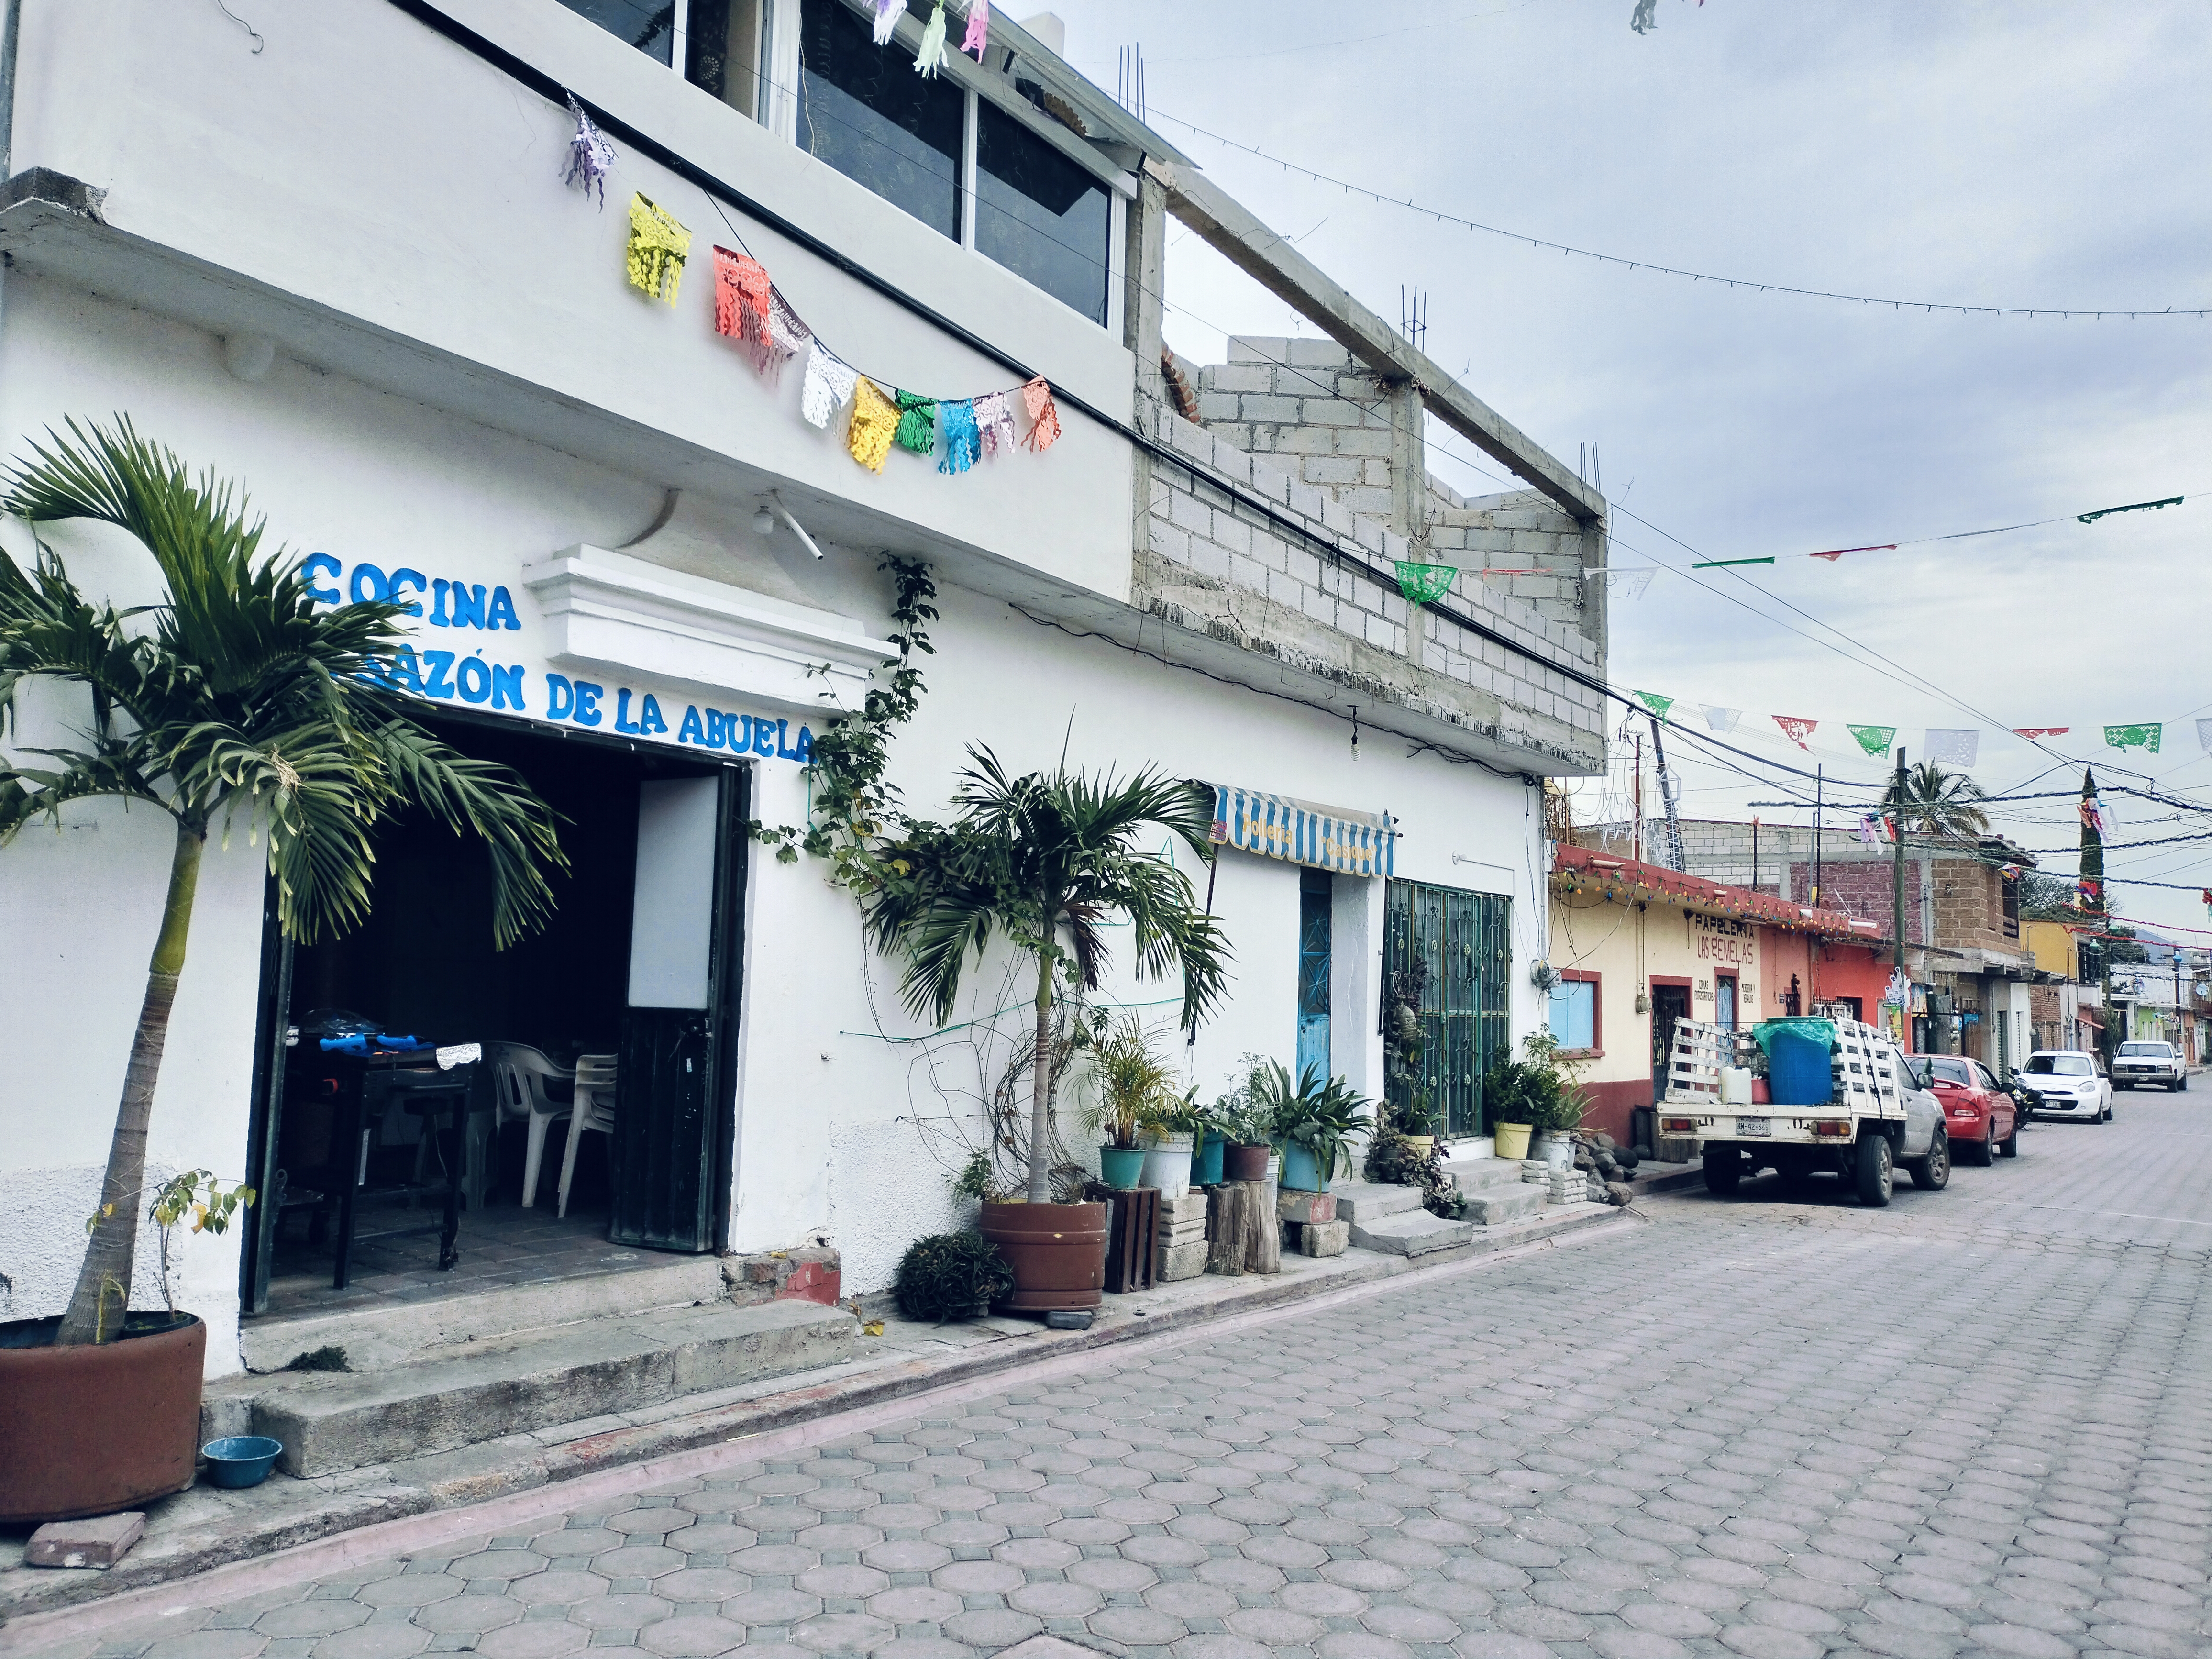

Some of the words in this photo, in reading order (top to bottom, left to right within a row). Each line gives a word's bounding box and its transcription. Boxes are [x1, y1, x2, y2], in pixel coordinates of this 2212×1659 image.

[301, 552, 521, 630] COCINA
[546, 673, 603, 726] DE
[615, 687, 668, 735] LA
[678, 705, 818, 764] ABUELA
[1698, 935, 1709, 959] LAS
